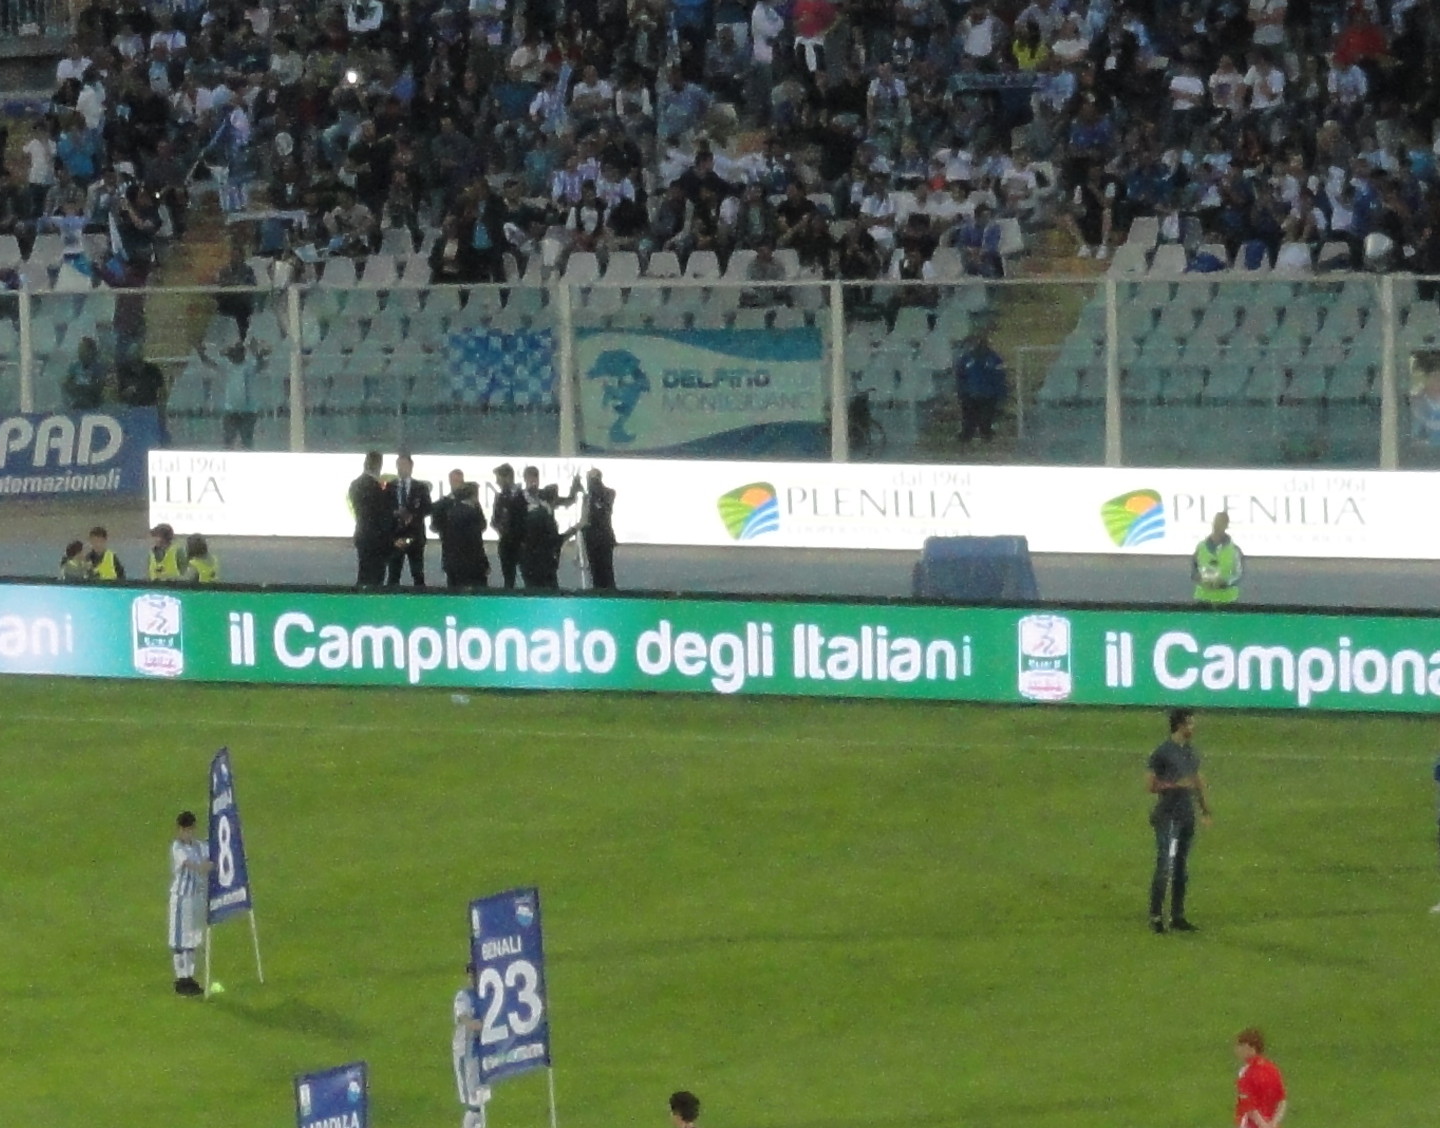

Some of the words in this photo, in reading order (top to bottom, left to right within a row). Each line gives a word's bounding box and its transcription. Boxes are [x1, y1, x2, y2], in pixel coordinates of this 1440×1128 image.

[786, 486, 972, 519] PLENILIA
[1173, 493, 1366, 525] PLENILIA
[229, 612, 256, 665] il
[273, 612, 618, 684] Campionato
[636, 619, 775, 694] degli
[793, 622, 972, 683] Italiani
[1104, 631, 1134, 688] il
[218, 815, 236, 887] 8
[478, 958, 544, 1046] 23
